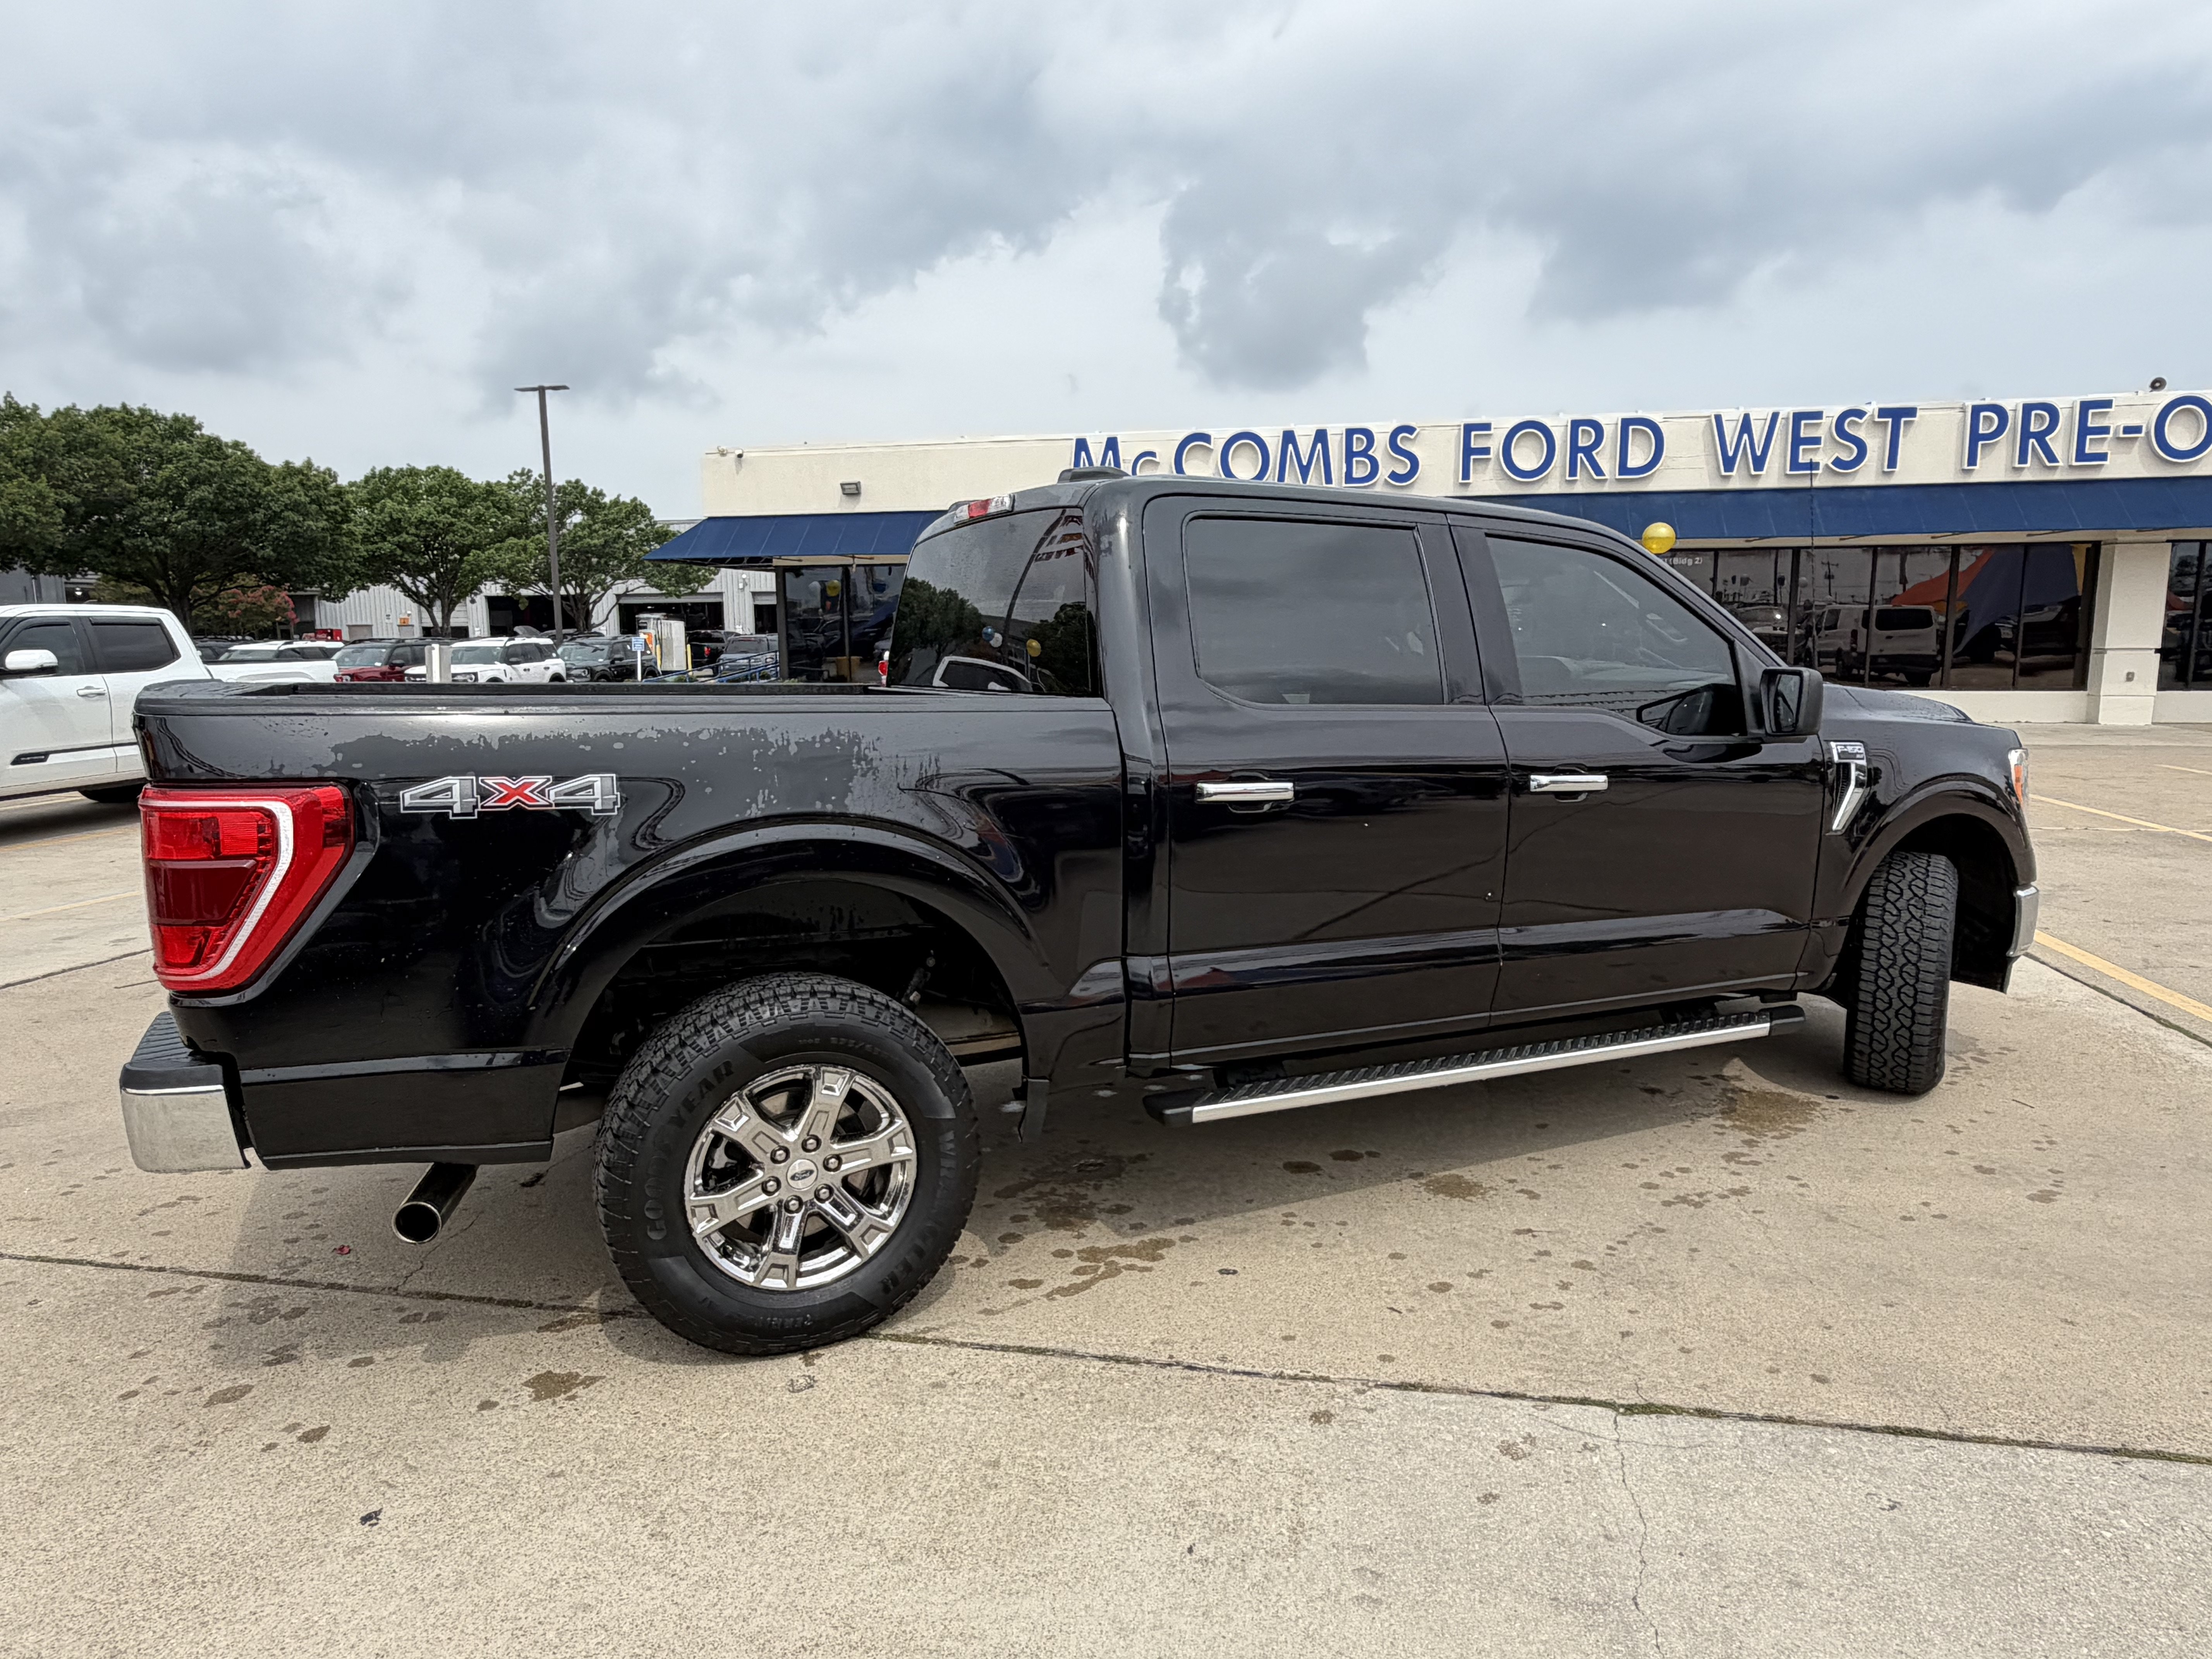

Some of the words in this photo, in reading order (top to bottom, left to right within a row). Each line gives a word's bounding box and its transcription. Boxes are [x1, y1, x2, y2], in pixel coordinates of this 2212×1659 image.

[1459, 416, 1666, 483] FORD
[1712, 406, 1918, 476] WEST
[1963, 393, 2212, 469] PRE-O
[400, 774, 620, 819] 4X4
